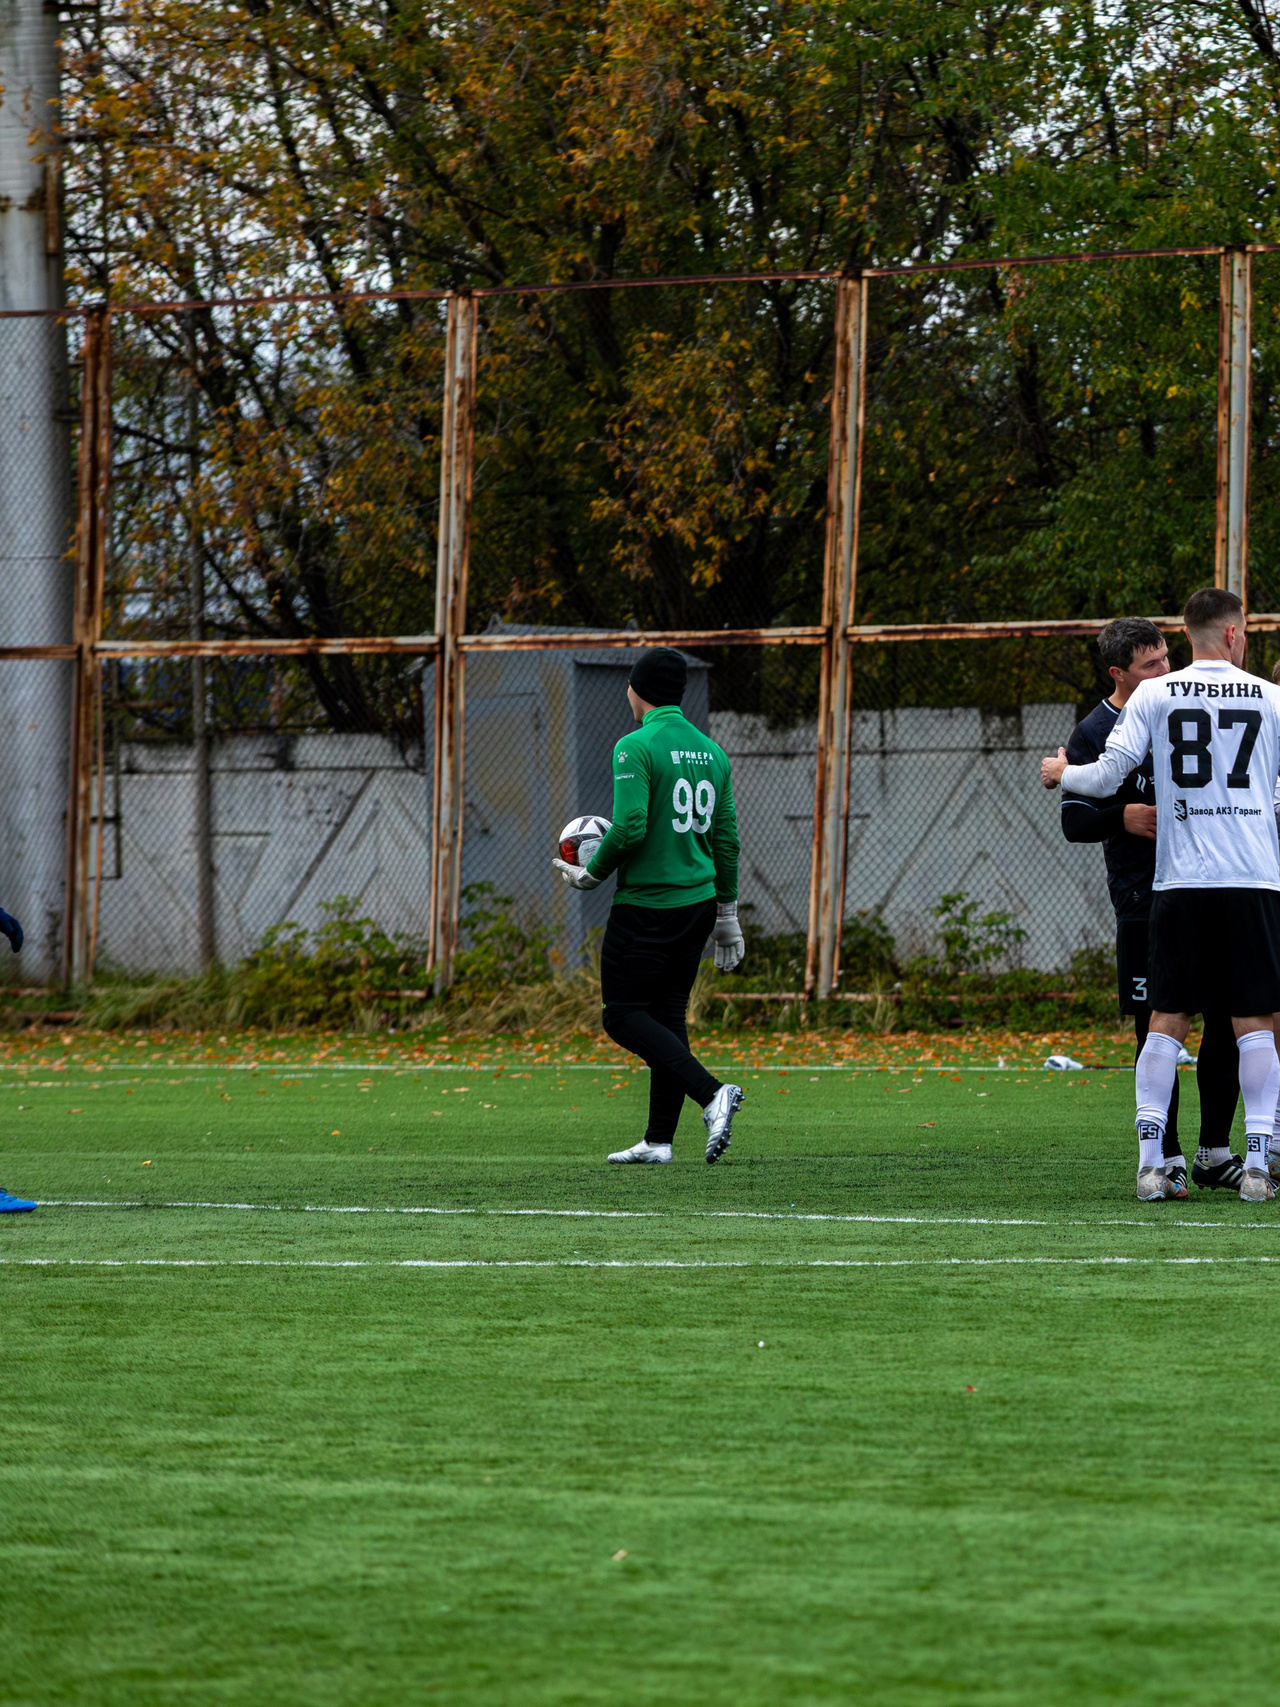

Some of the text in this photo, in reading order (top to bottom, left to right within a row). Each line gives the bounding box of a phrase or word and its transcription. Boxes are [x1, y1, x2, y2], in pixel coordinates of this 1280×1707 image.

[1166, 681, 1263, 699] ТУРБИНА
[1168, 708, 1262, 789] 87
[672, 777, 716, 834] 99
[1189, 807, 1213, 816] Завод
[1234, 807, 1262, 817] Гарант
[1132, 977, 1147, 1000] 3
[1140, 1125, 1159, 1140] FS
